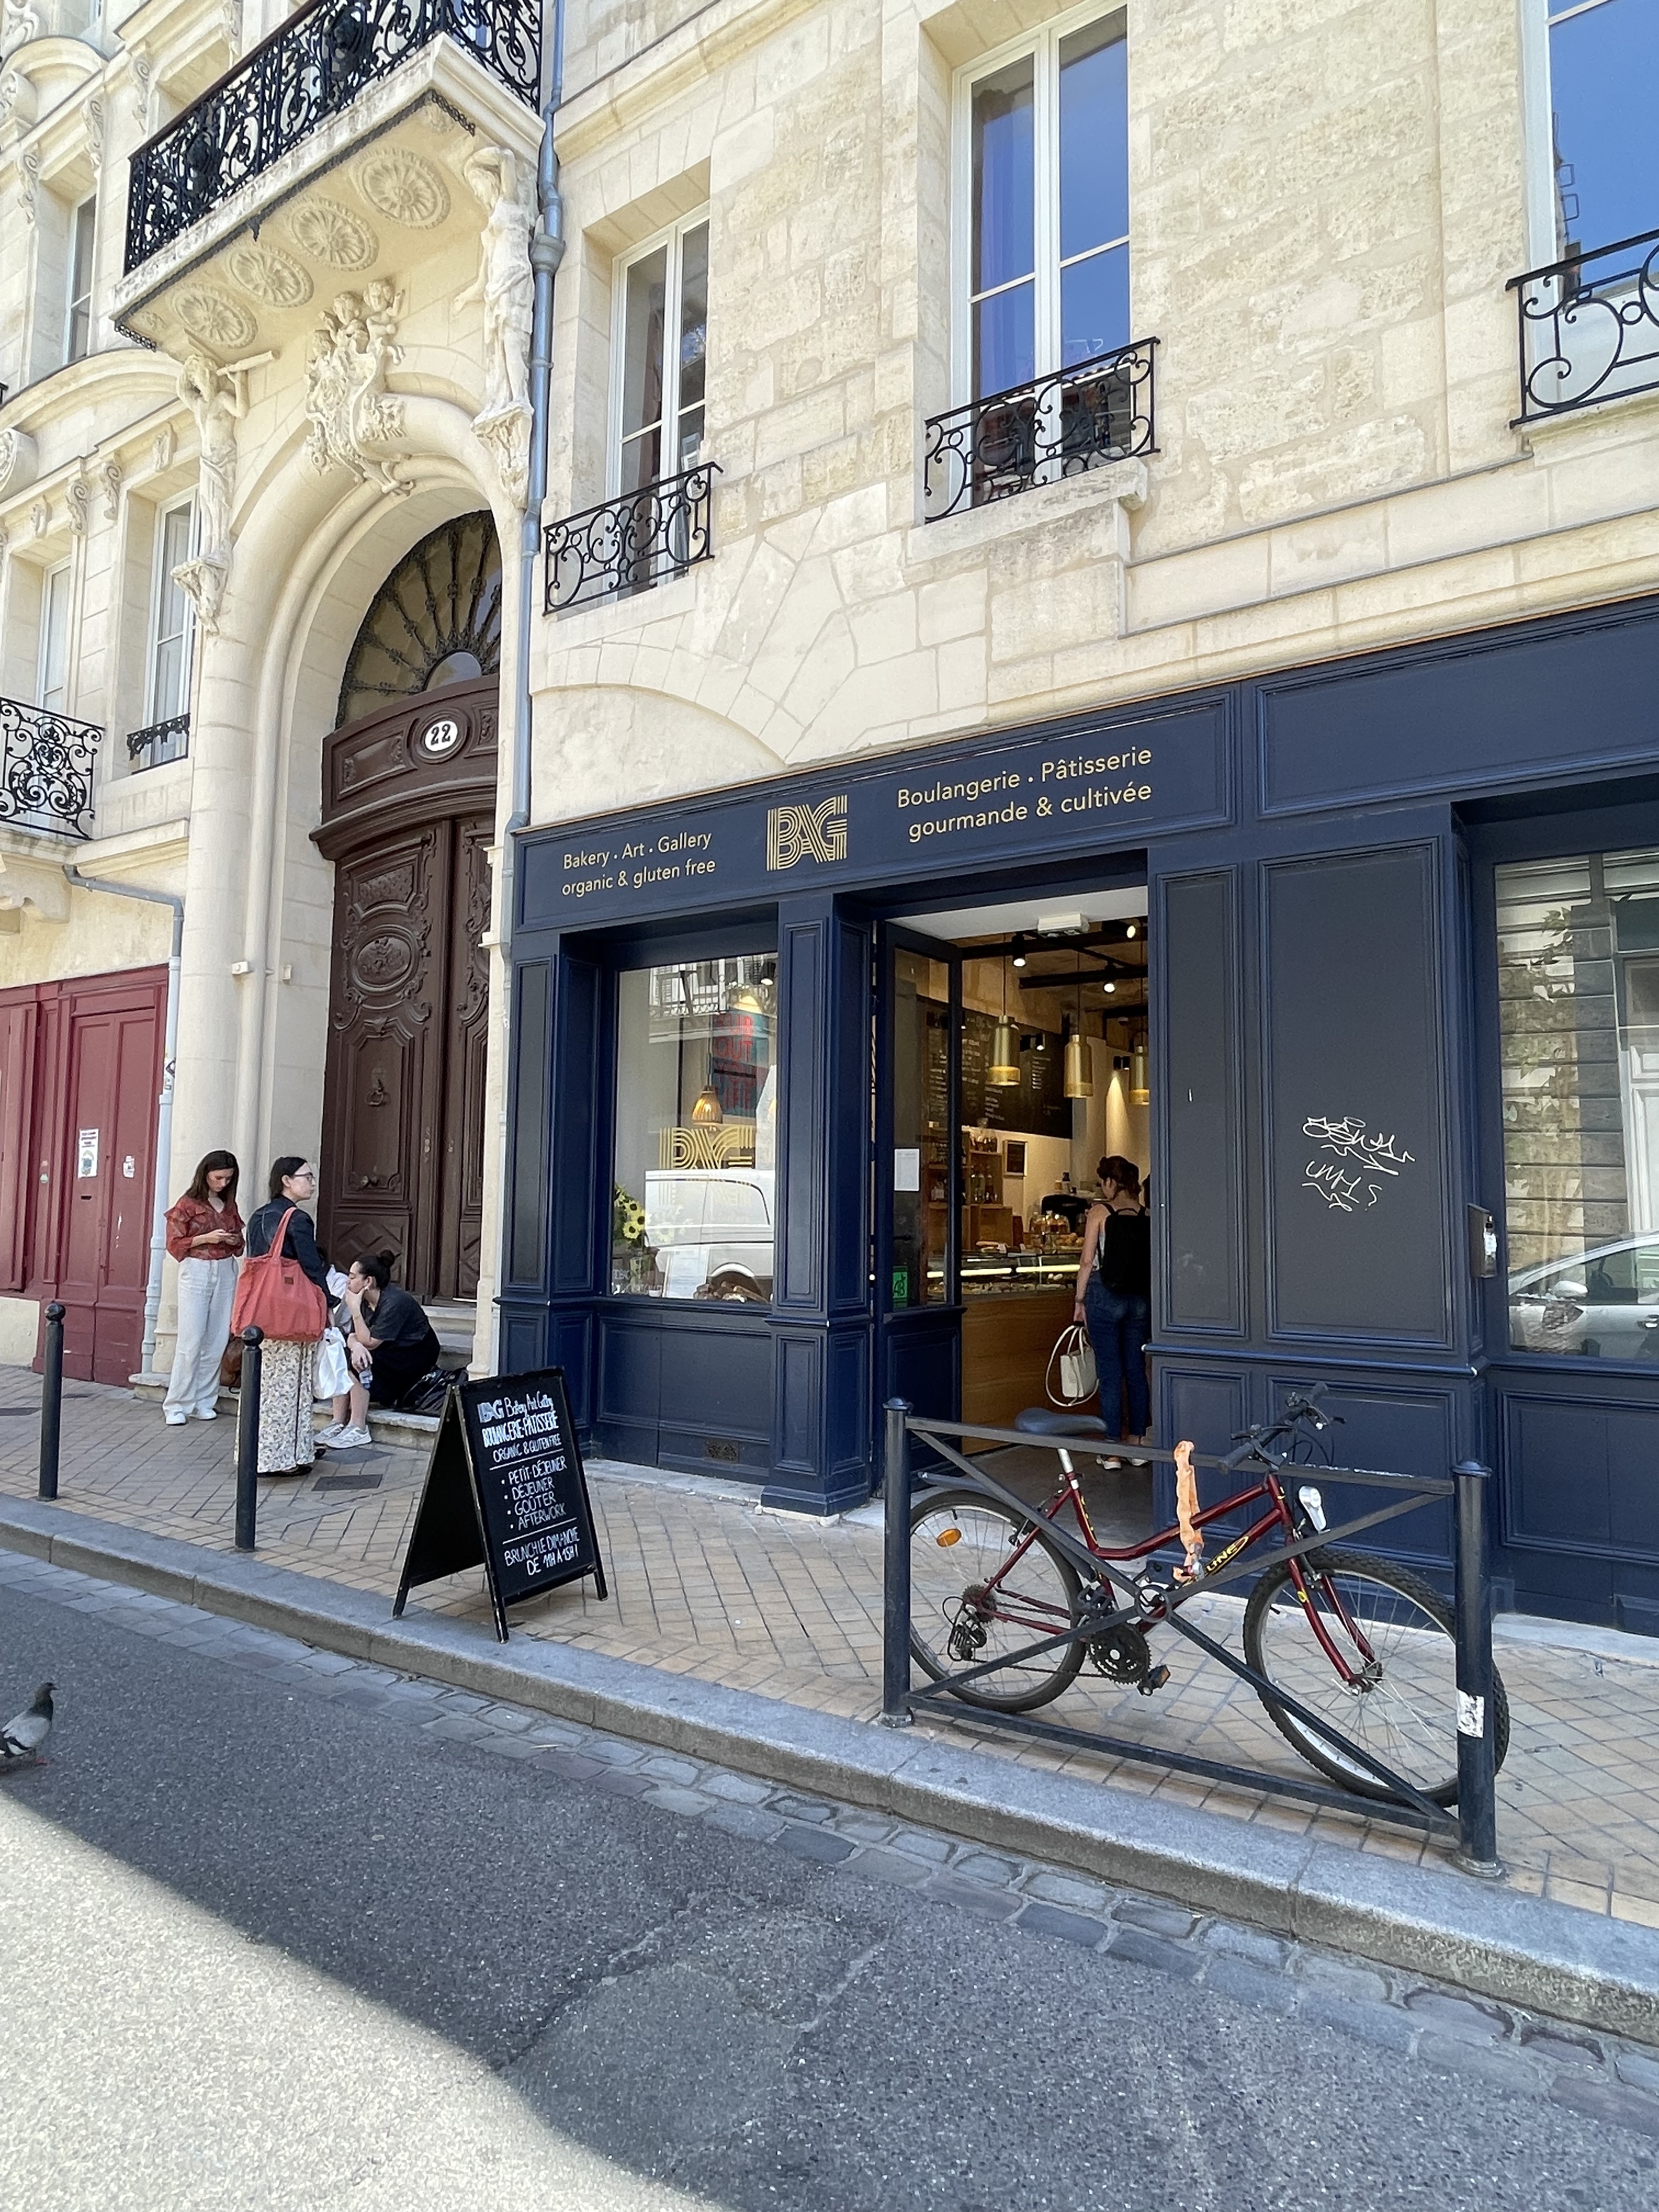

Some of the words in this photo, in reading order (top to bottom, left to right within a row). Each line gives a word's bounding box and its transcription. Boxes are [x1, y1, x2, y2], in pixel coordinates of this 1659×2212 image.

[431, 723, 451, 746] 22
[898, 770, 1020, 808] Boulangerie
[1041, 746, 1152, 782] Pâtisserie
[908, 801, 1029, 843] gourmande
[1036, 796, 1053, 817] &
[1060, 781, 1152, 813] cultivée
[563, 850, 610, 870] Bakery
[621, 843, 645, 860] Art
[657, 832, 712, 853] Gallery
[766, 794, 848, 872] BAG
[561, 874, 614, 898] organic
[617, 870, 629, 887] &
[633, 866, 680, 889] gluten
[685, 858, 716, 876] free
[527, 1556, 542, 1576] DE
